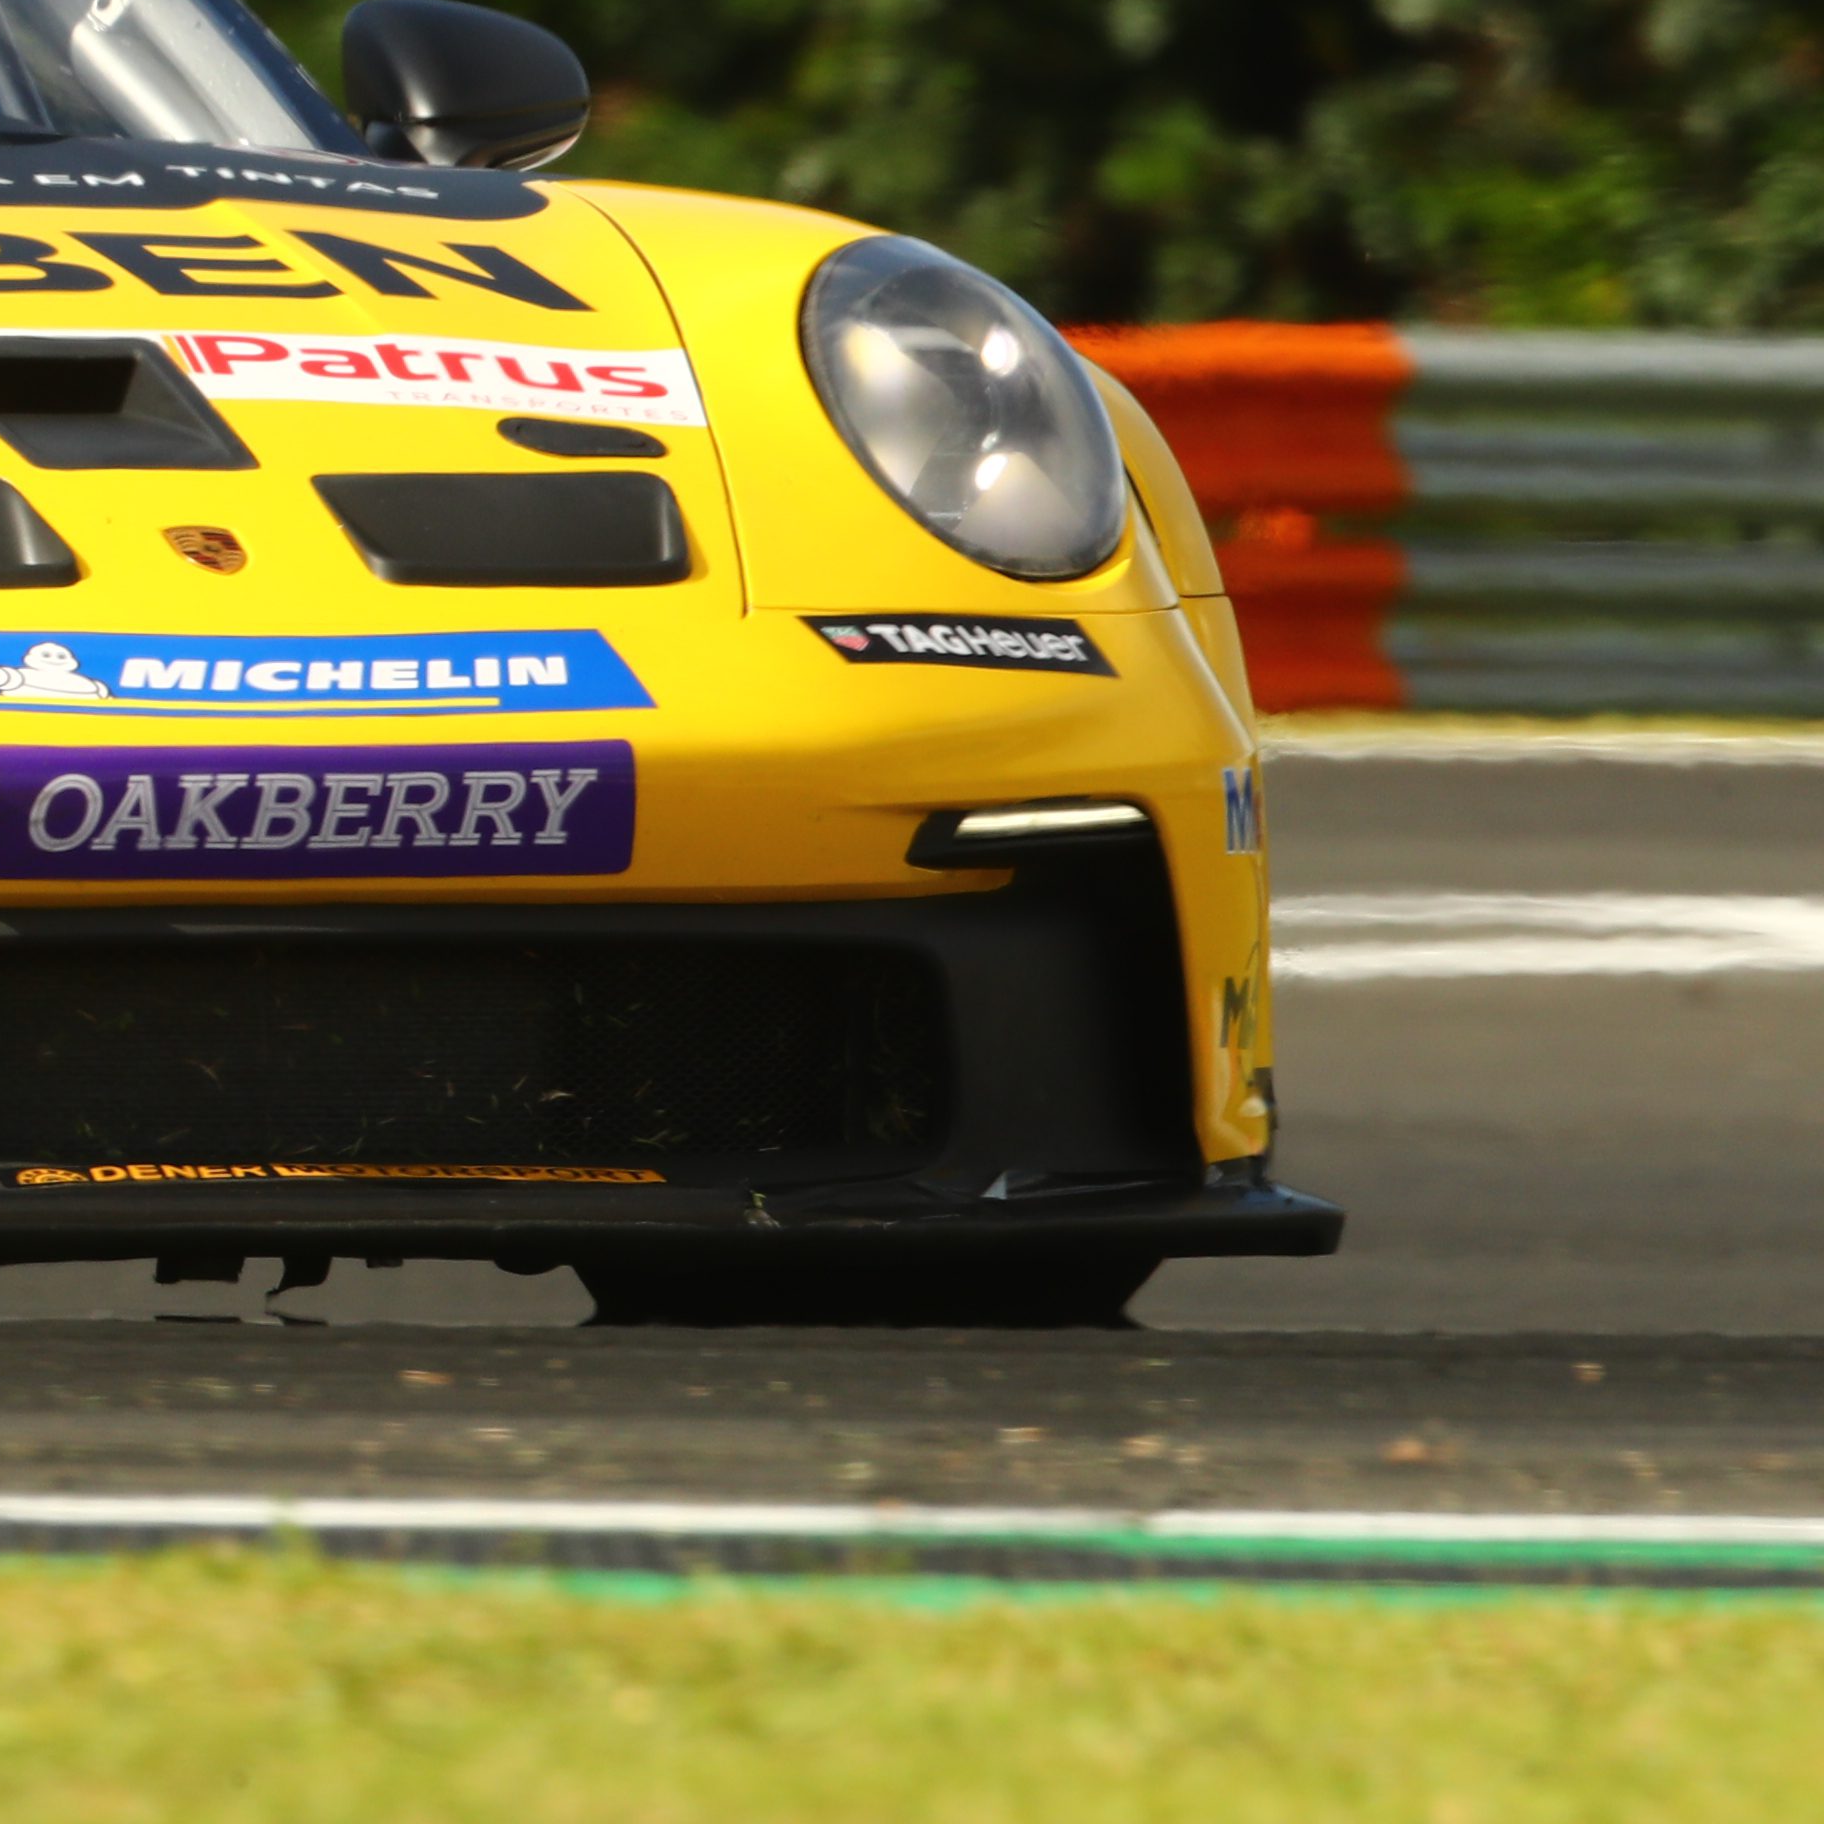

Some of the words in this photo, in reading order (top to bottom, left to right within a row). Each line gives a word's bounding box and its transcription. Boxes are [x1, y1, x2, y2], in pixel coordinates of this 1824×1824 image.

[33, 172, 146, 188] EM
[164, 164, 440, 200] TINTAS
[192, 333, 670, 399] Patrus
[386, 389, 689, 422] TRANSPORTES
[119, 655, 569, 693] MICHELIN
[27, 769, 598, 854] OAKBERRY
[89, 1163, 268, 1182] DENER
